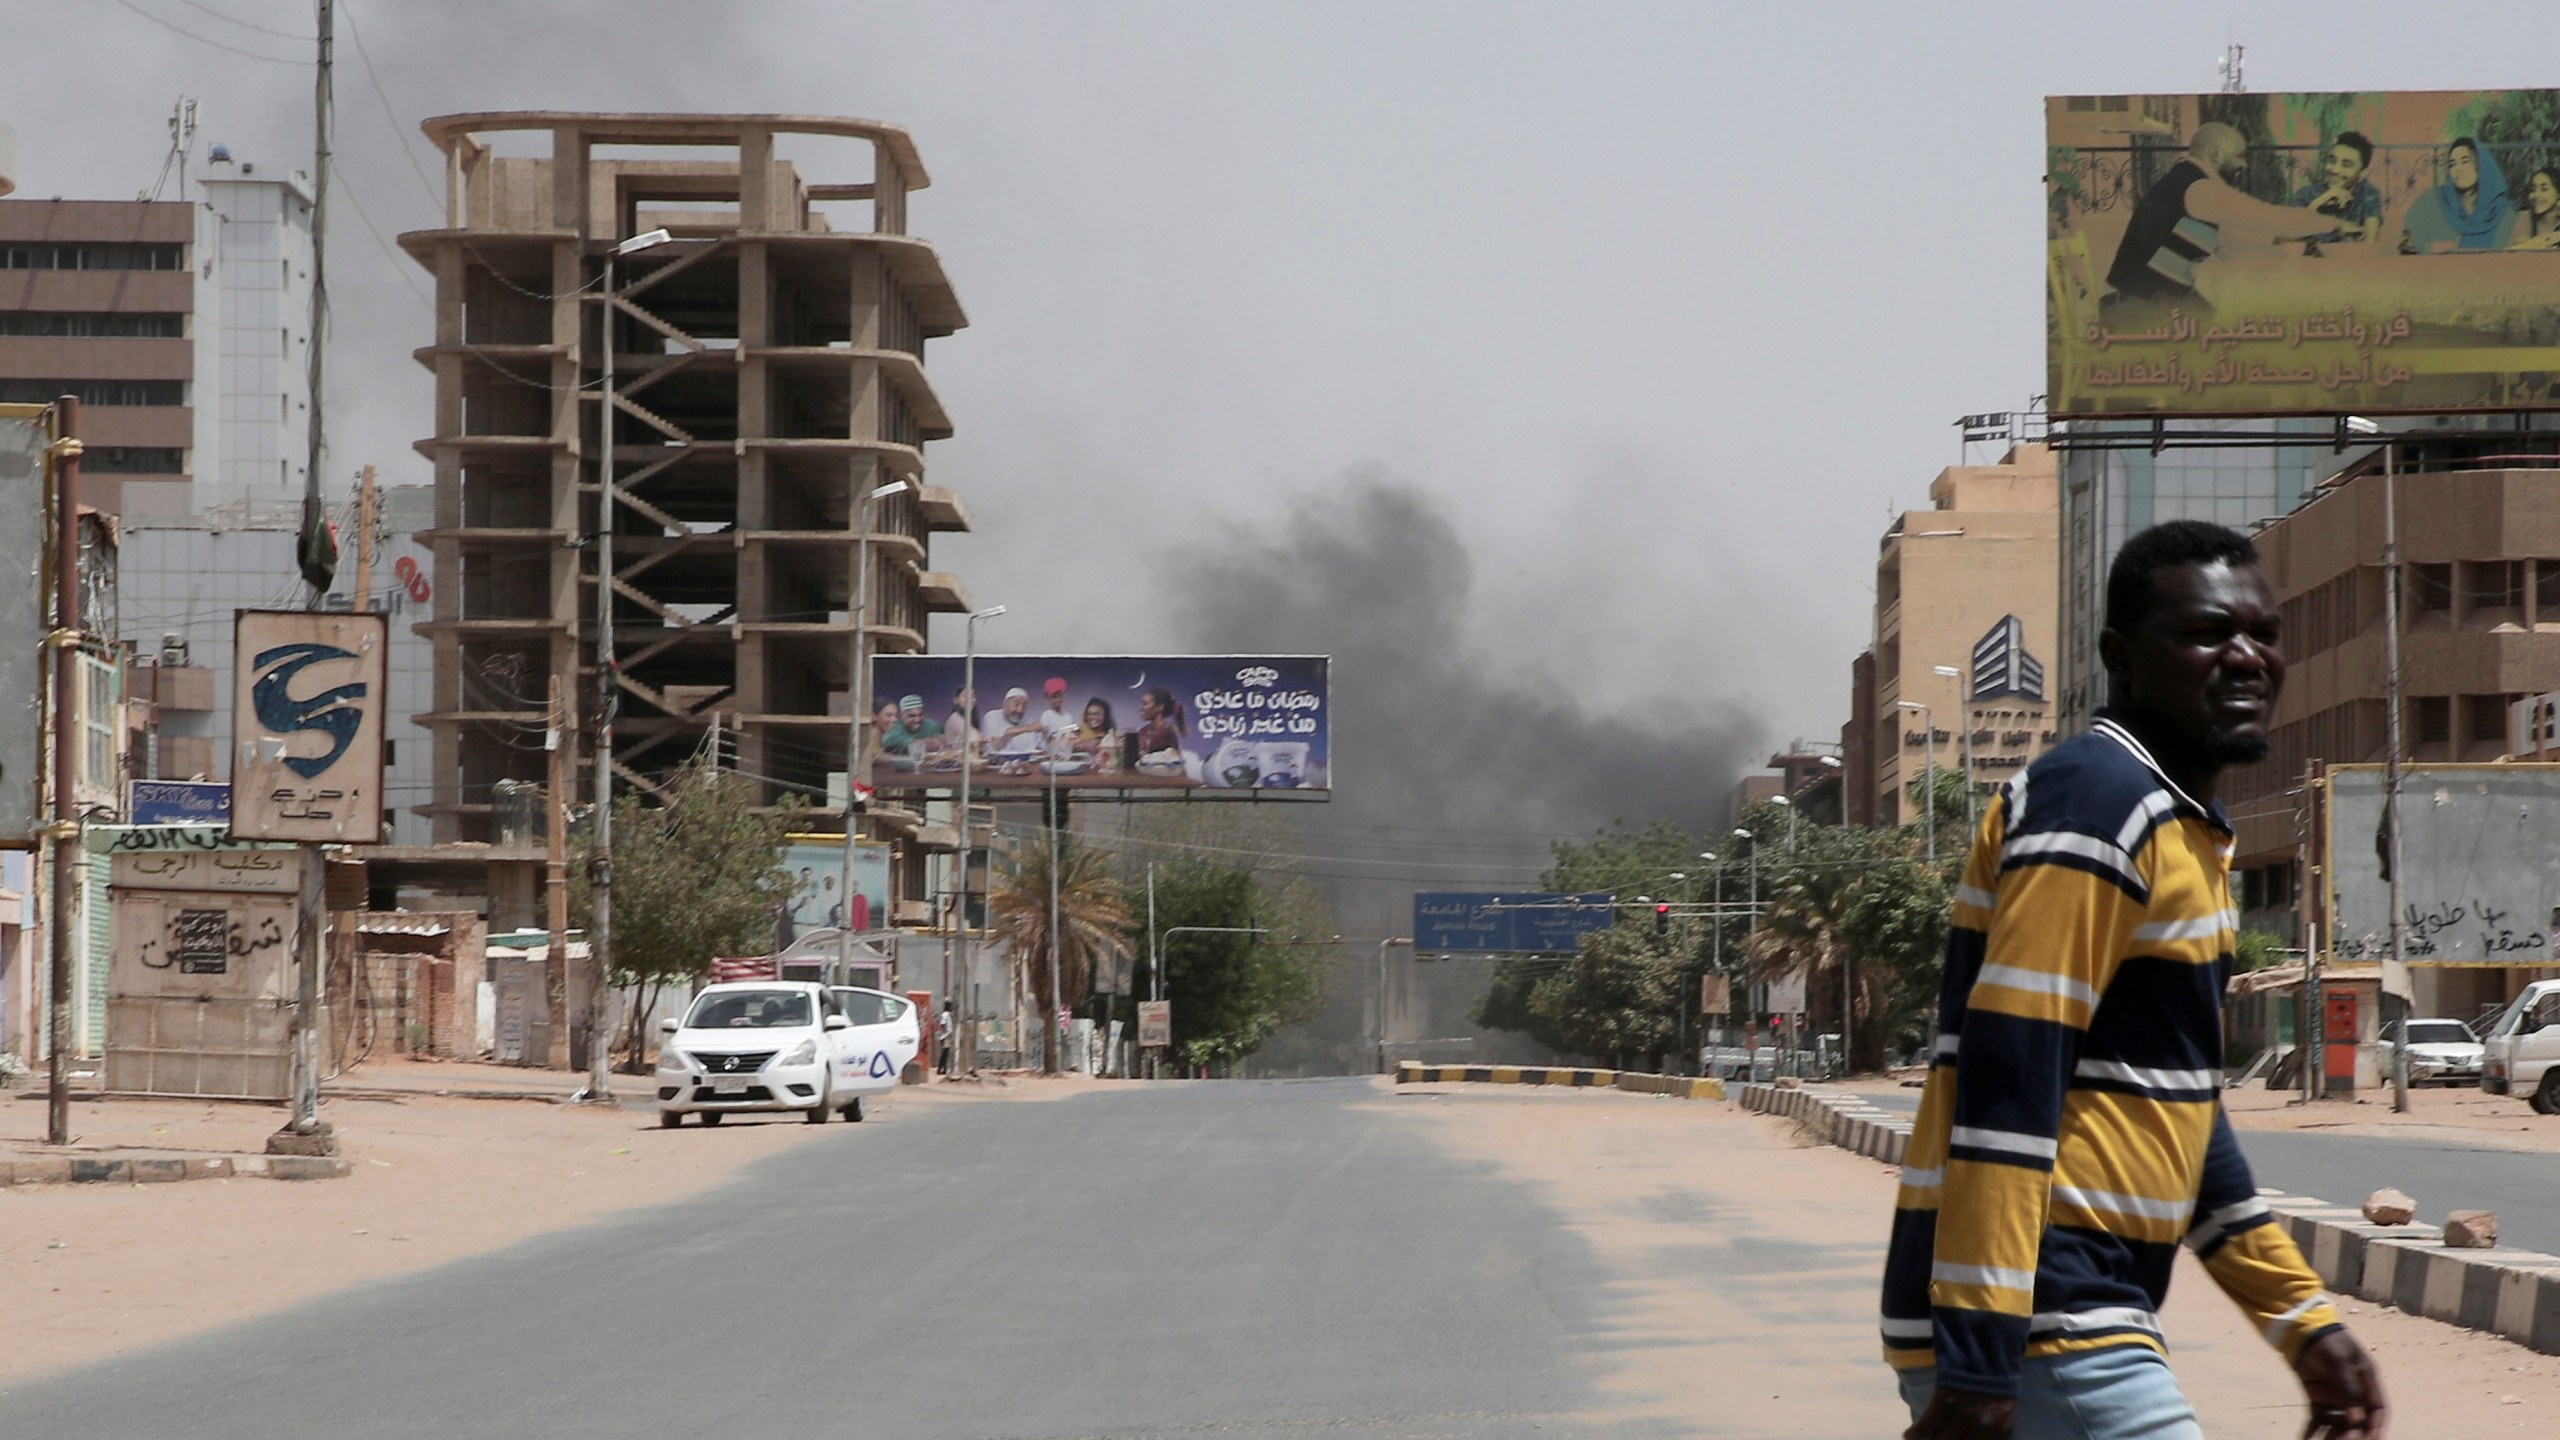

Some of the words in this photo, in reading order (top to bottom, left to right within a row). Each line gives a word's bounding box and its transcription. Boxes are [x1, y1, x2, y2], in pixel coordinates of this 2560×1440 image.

[2202, 315, 2284, 350] تنظيم
[2290, 305, 2367, 347] وأختار
[2373, 309, 2410, 346] قرر
[2085, 352, 2193, 392] وأطفالها
[2197, 352, 2243, 393] الأم
[2249, 361, 2316, 383] صحة
[2320, 350, 2371, 390] أجل
[2375, 362, 2411, 387] من
[1246, 690, 1265, 709] ما
[1267, 689, 1320, 711] رمضان
[1198, 712, 1247, 738] زبادي
[1287, 712, 1317, 736] من
[214, 850, 284, 876] مكتبة
